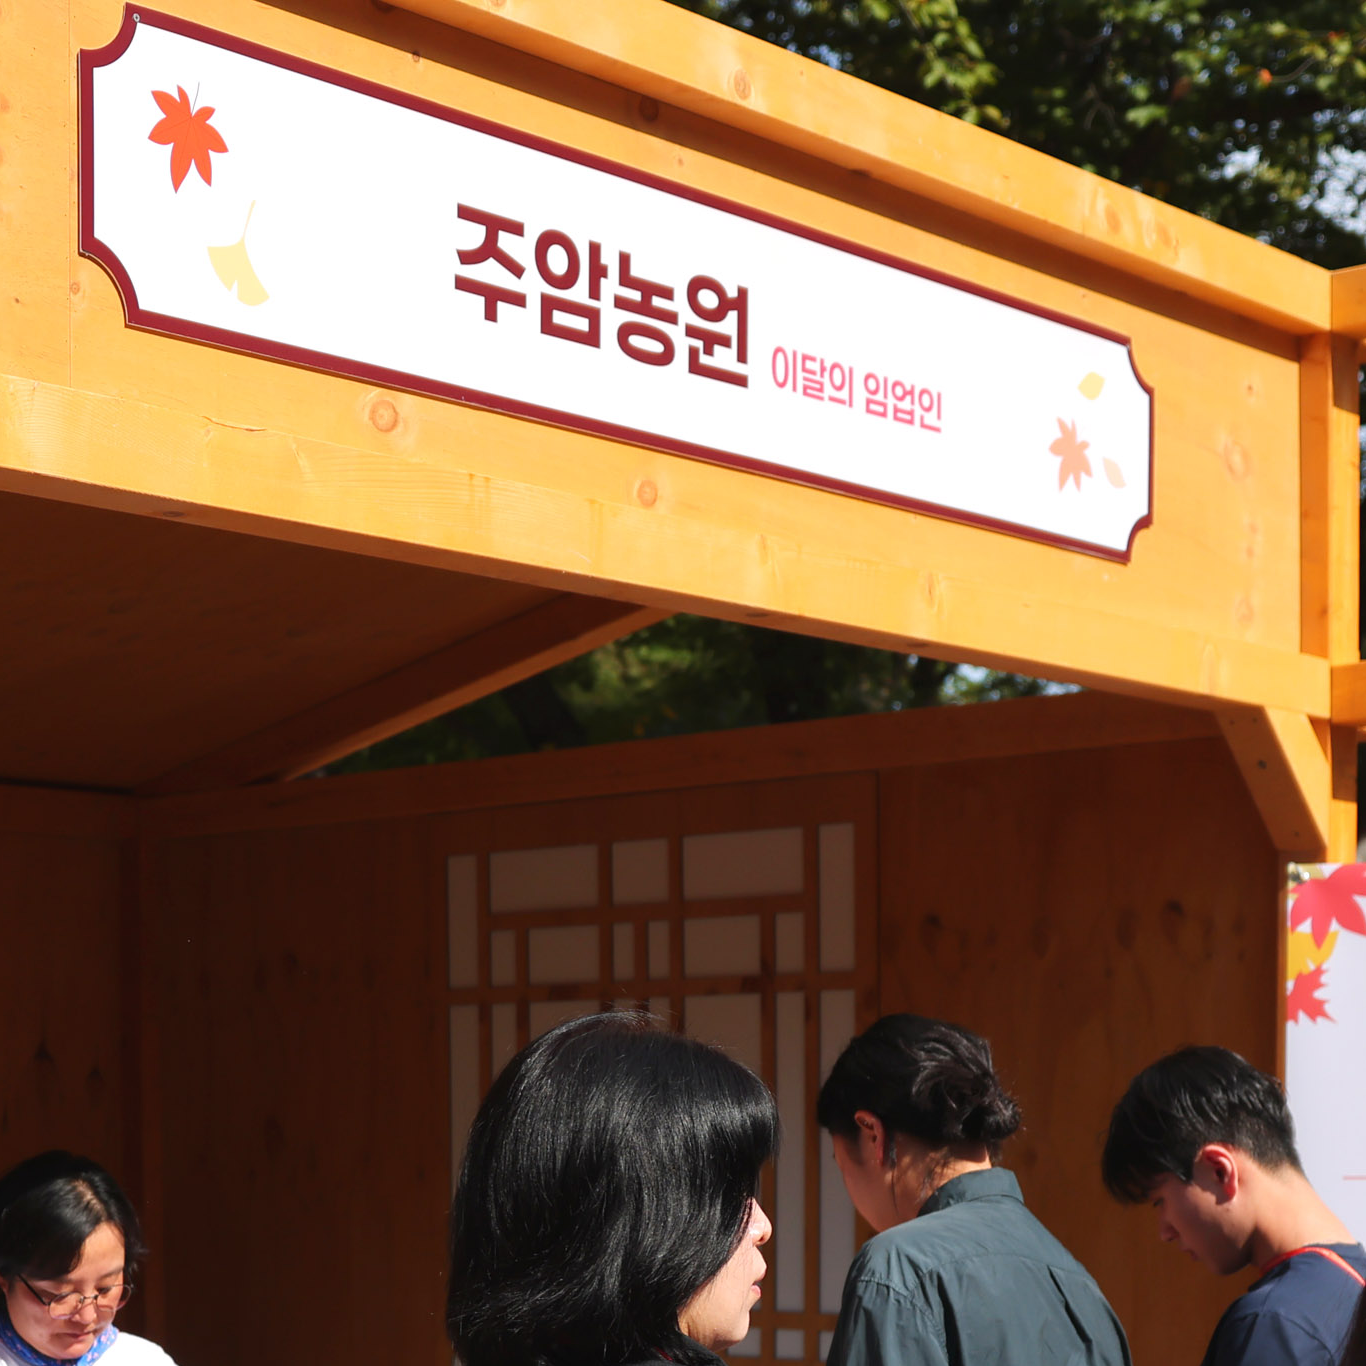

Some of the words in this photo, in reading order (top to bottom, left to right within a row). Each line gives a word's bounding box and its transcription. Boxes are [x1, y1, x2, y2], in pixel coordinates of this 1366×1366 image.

[454, 202, 749, 388] 주암농원
[771, 346, 854, 409] 이달의
[863, 371, 942, 434] 임업인
